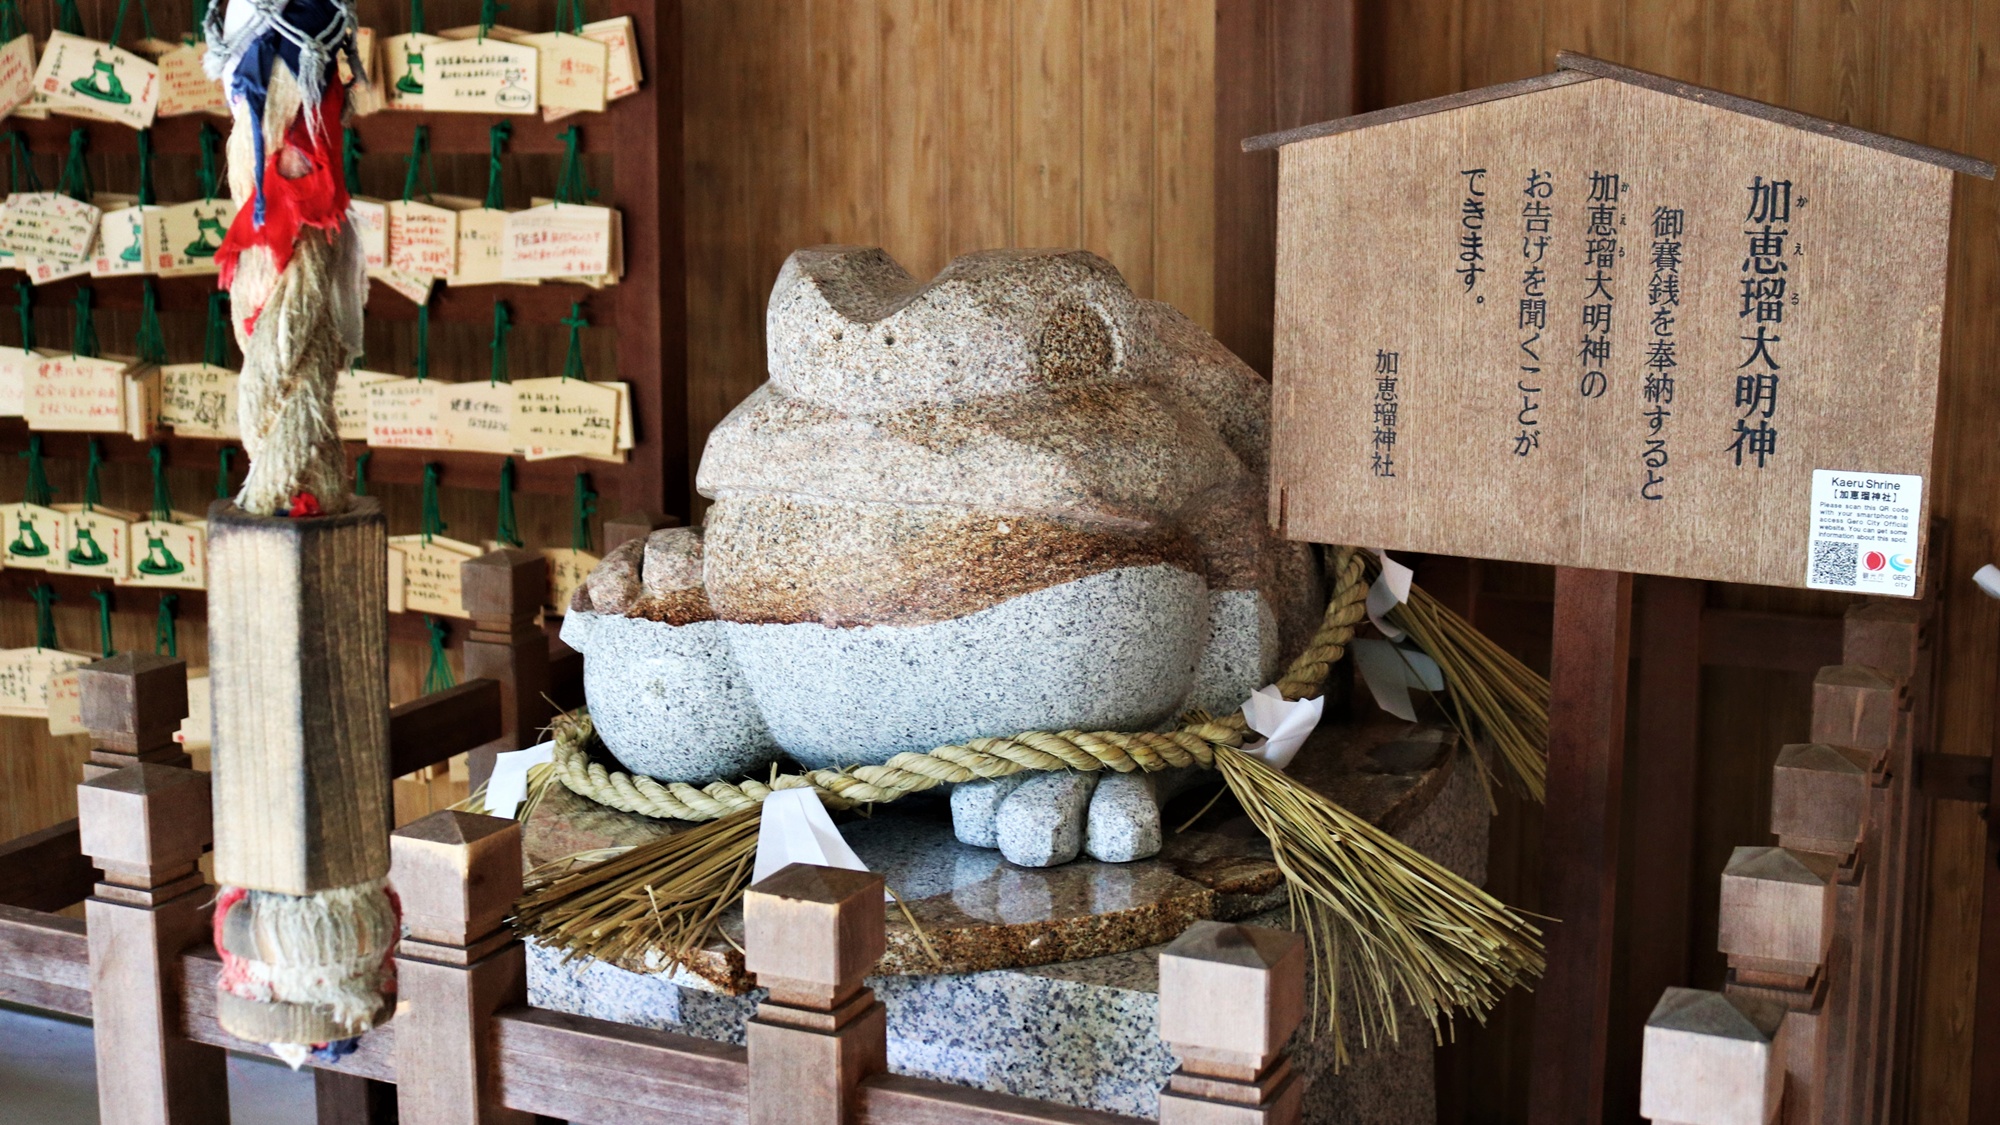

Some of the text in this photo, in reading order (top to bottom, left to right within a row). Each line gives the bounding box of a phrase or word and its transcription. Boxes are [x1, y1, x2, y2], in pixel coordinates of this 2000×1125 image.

[1455, 167, 1488, 305] できます。
[1576, 170, 1619, 399] 加恵瑠大明神の
[1512, 168, 1554, 457] お告げを聞くことが
[1640, 205, 1685, 501] 御賽銭を奉納すると
[1725, 176, 1793, 468] 加恵瑠大明神
[1370, 348, 1400, 478] 加恵瑠神社
[1831, 477, 1901, 490] Kaeru Shrine
[1857, 512, 1897, 520] smartphone
[1867, 519, 1880, 527] City
[1884, 520, 1908, 528] Official
